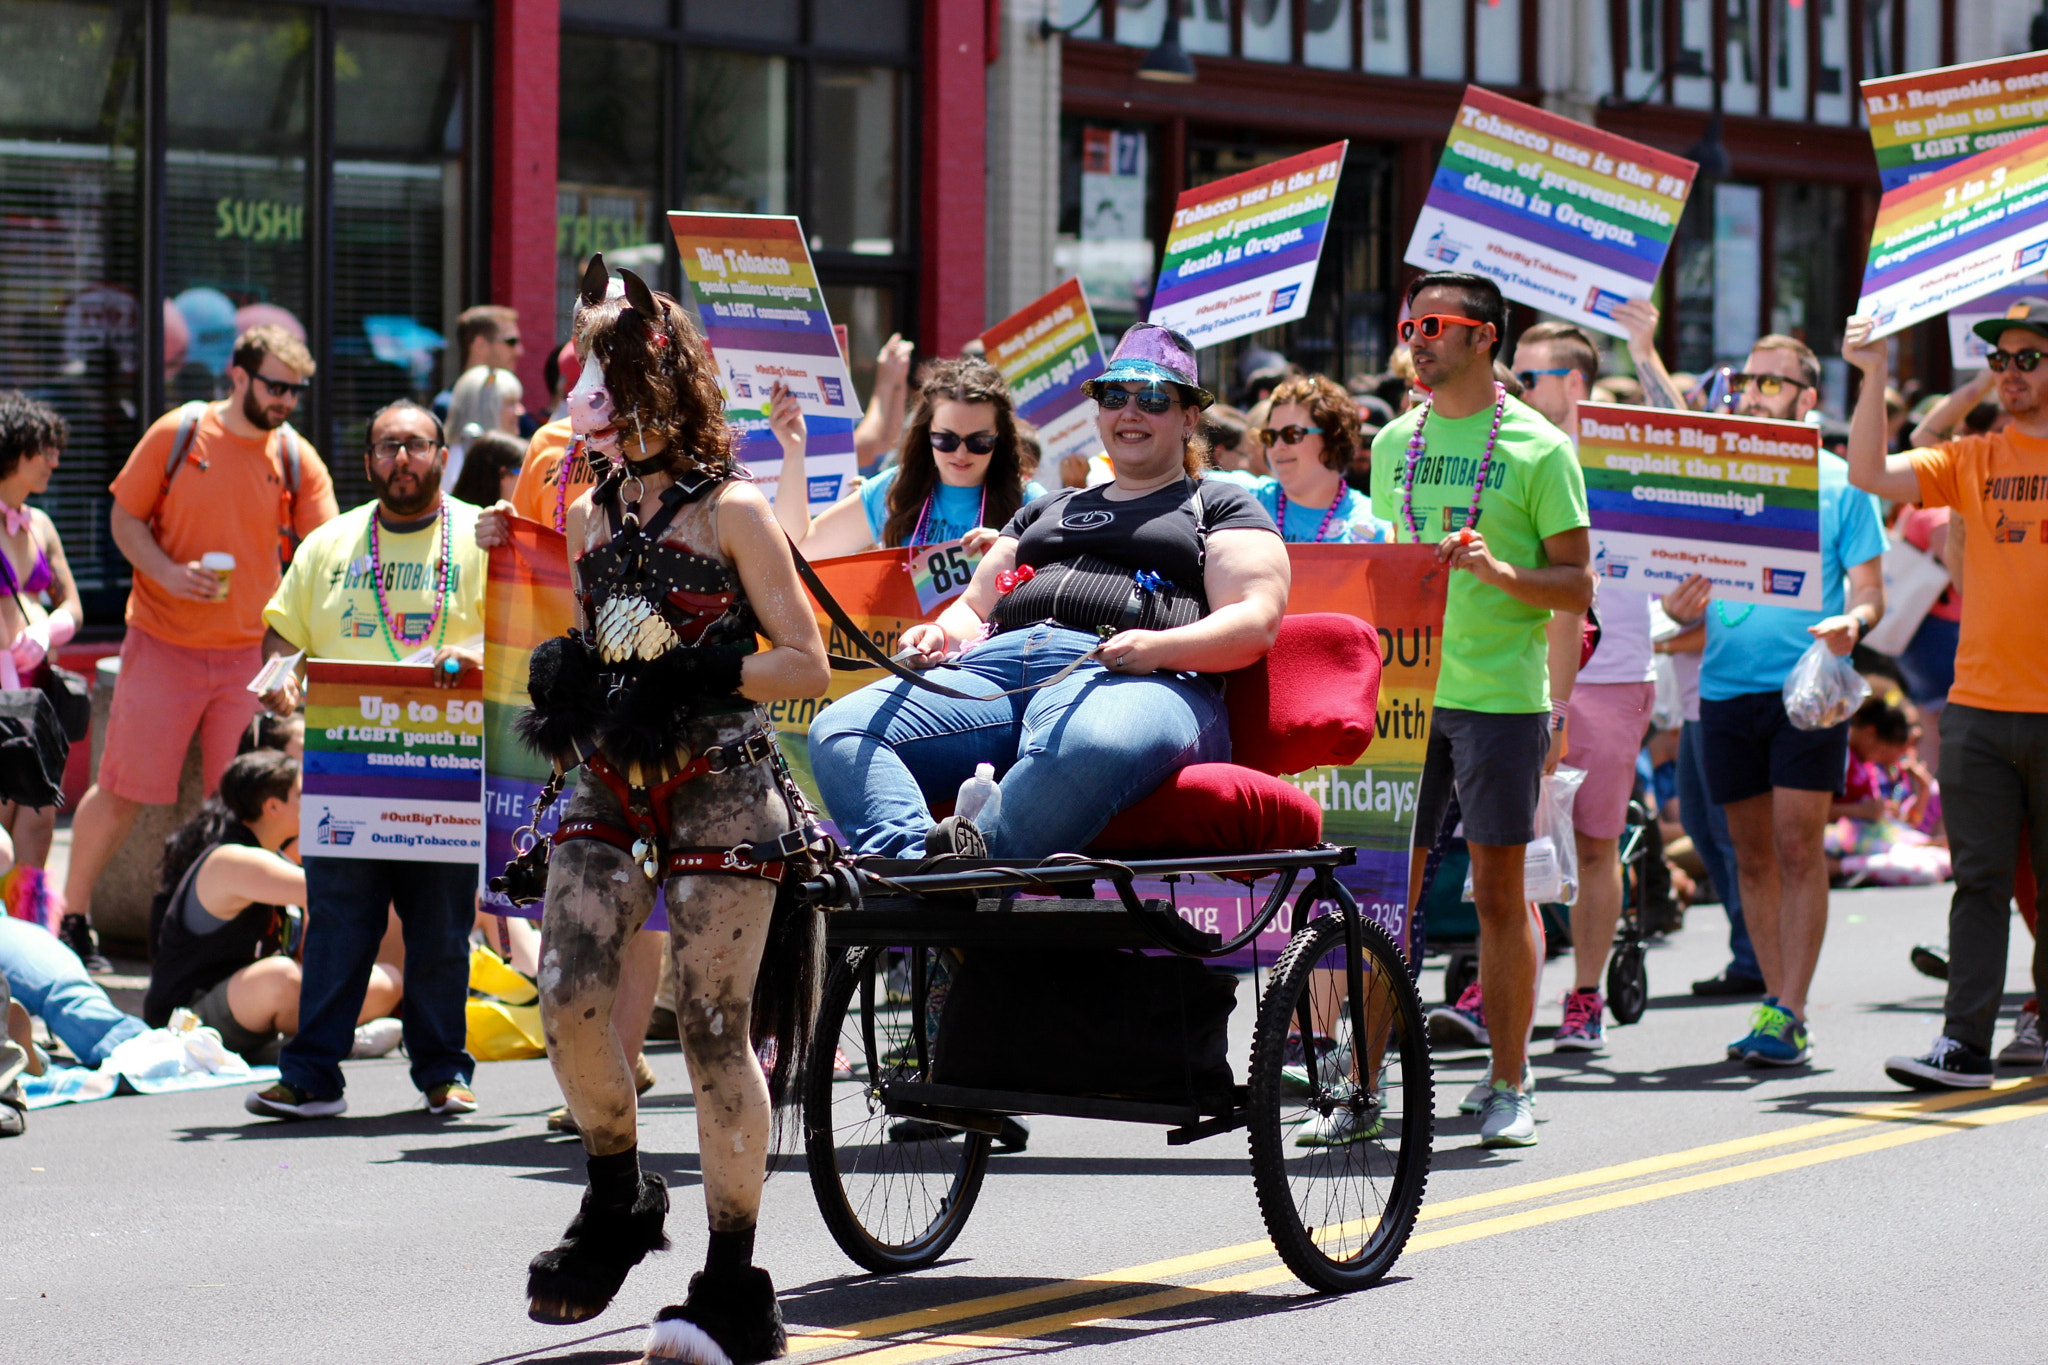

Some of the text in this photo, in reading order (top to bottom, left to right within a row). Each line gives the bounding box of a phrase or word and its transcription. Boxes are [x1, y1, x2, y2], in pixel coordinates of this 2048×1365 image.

[1866, 93, 1904, 115] R.J.
[1906, 77, 2001, 108] Reynolds
[1894, 119, 1921, 137] its
[1924, 112, 1971, 136] plan
[1974, 107, 1996, 123] to
[1462, 105, 1686, 200] Tobacco use is the #1
[1912, 134, 1970, 161] LGBT
[1175, 160, 1338, 228] Tobacco use is the #1
[1453, 140, 1671, 227] cause of preventable
[1960, 180, 1985, 202] in
[1989, 166, 2007, 189] 3
[1463, 171, 1637, 247] death in Oregon.
[1973, 190, 2003, 212] and
[216, 197, 304, 242] SUSHI
[556, 214, 647, 254] FRESH
[1170, 192, 1328, 255] cause of preventable
[1957, 208, 2005, 235] smoke
[695, 247, 790, 278] Big Tobacco
[1178, 227, 1304, 277] death in Oregon.
[767, 283, 812, 302] targeting
[713, 301, 729, 316] the
[729, 302, 756, 318] LGBT
[1050, 360, 1075, 386] age
[1071, 345, 1091, 371] 21
[1581, 418, 1814, 460] Don't let Big Tobacco
[1605, 453, 1790, 485] exploit the LGBT
[1632, 485, 1765, 516] community!
[927, 545, 973, 595] 85
[1651, 548, 1747, 567] #OutBigTobacco
[359, 695, 483, 726] Up to 50
[325, 725, 478, 747] of LGBT youth in
[367, 752, 426, 767] smoke
[485, 791, 524, 818] THE
